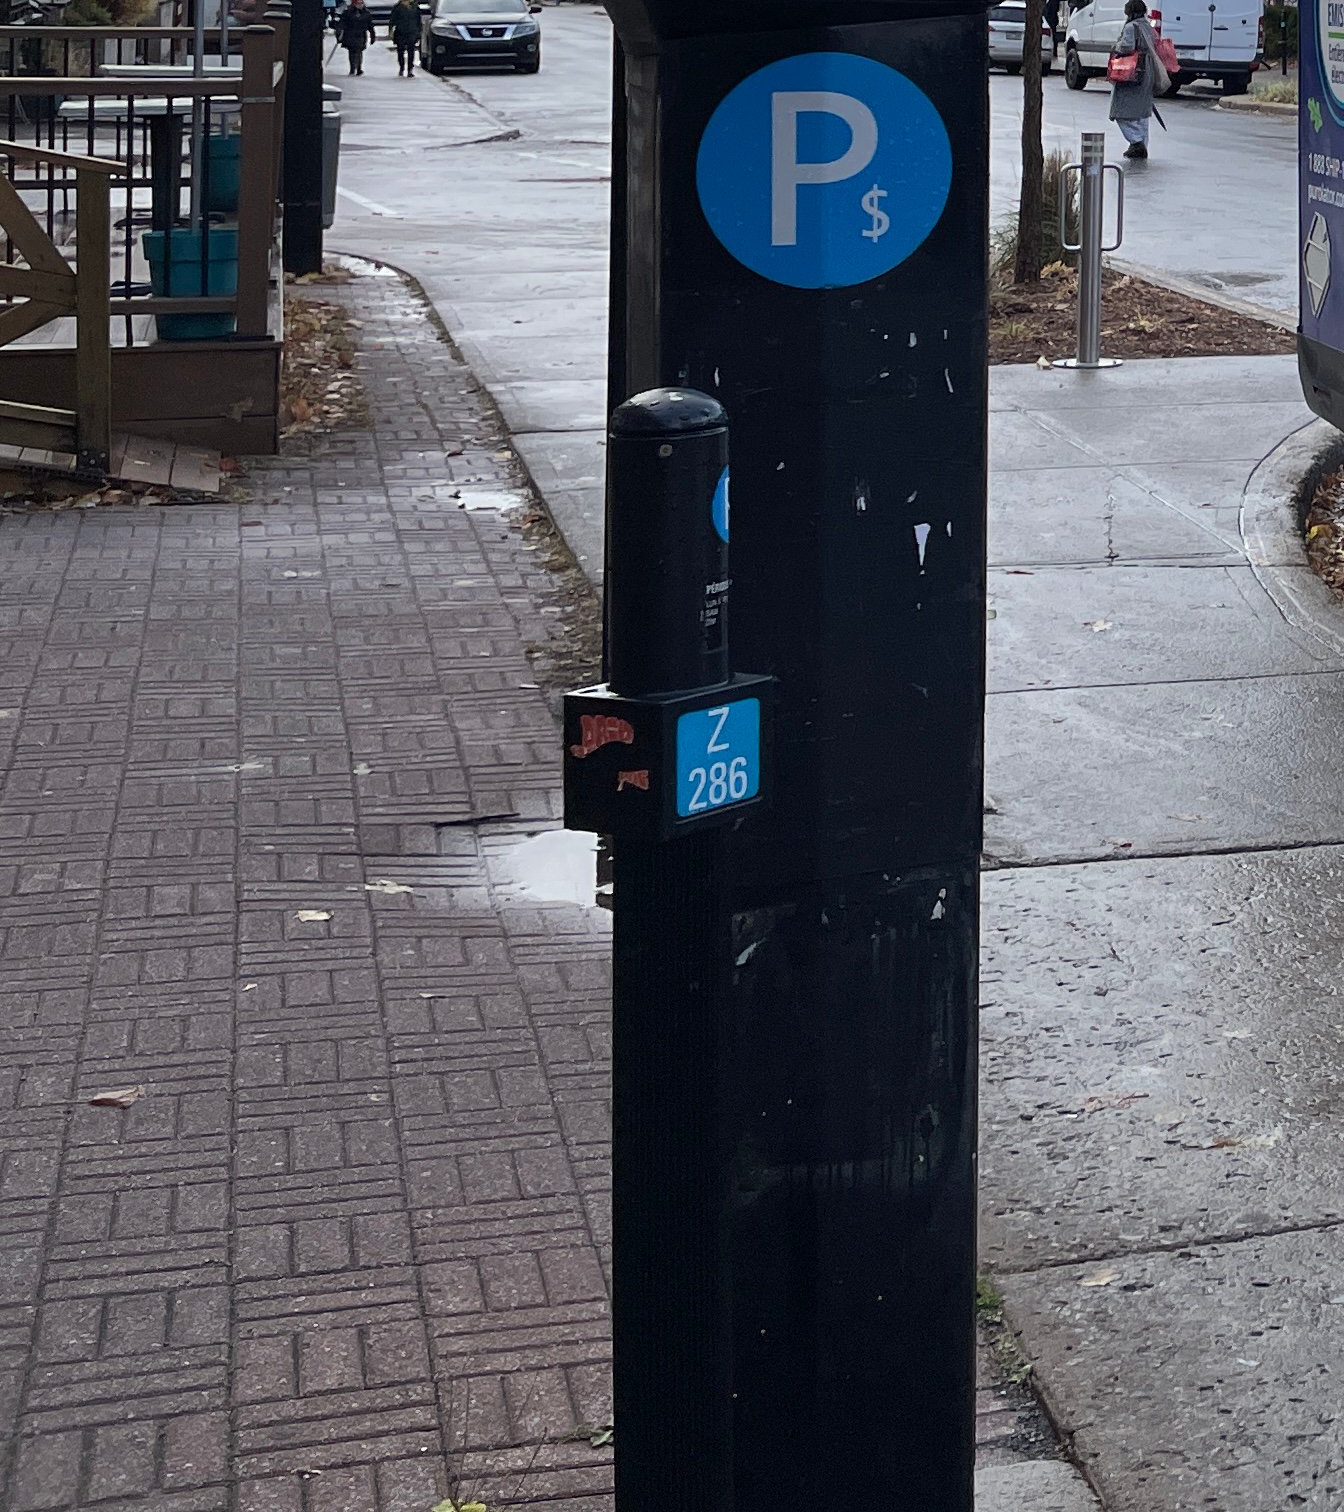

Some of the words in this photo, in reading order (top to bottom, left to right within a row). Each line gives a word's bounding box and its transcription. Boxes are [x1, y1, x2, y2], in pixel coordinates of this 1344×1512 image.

[771, 91, 878, 246] P
[707, 706, 730, 755] Z
[688, 756, 748, 812] 286
